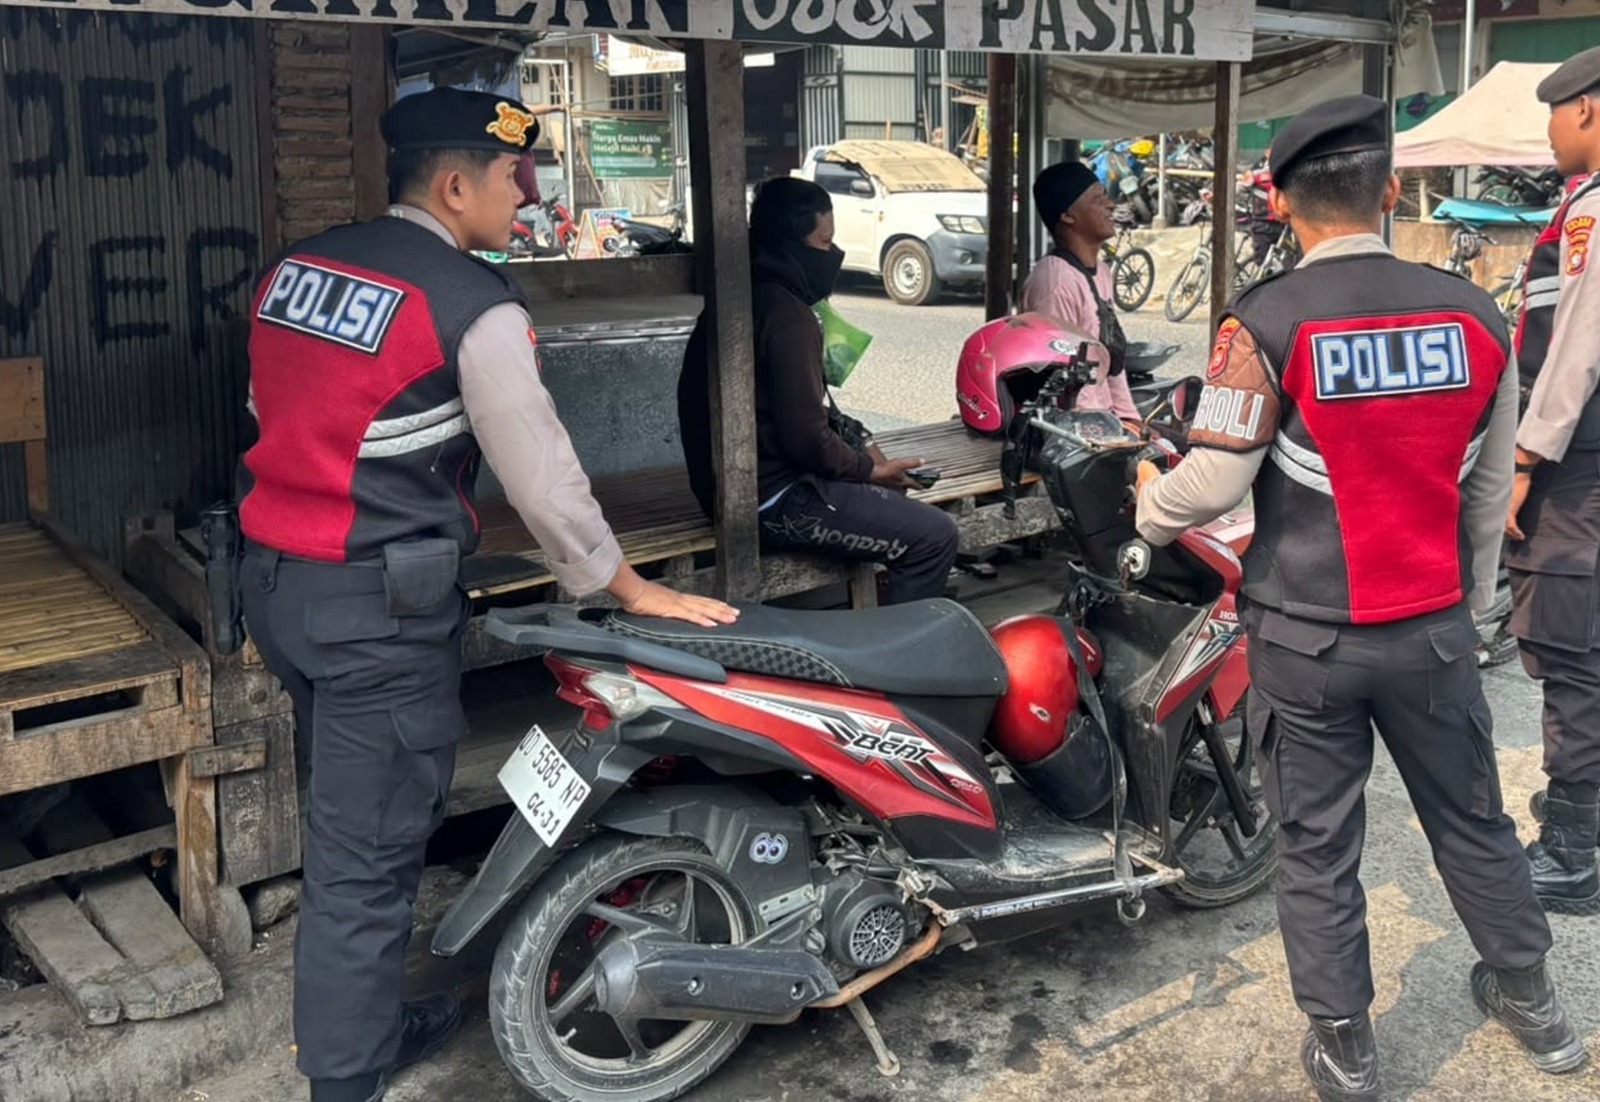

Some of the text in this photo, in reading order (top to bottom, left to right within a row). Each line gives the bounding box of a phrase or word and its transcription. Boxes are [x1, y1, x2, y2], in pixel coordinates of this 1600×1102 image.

[978, 0, 1195, 55] PASAR
[261, 263, 395, 346] POLISI
[1319, 328, 1465, 394] POLISI
[809, 525, 908, 560] Reebok
[532, 744, 566, 788] 5585
